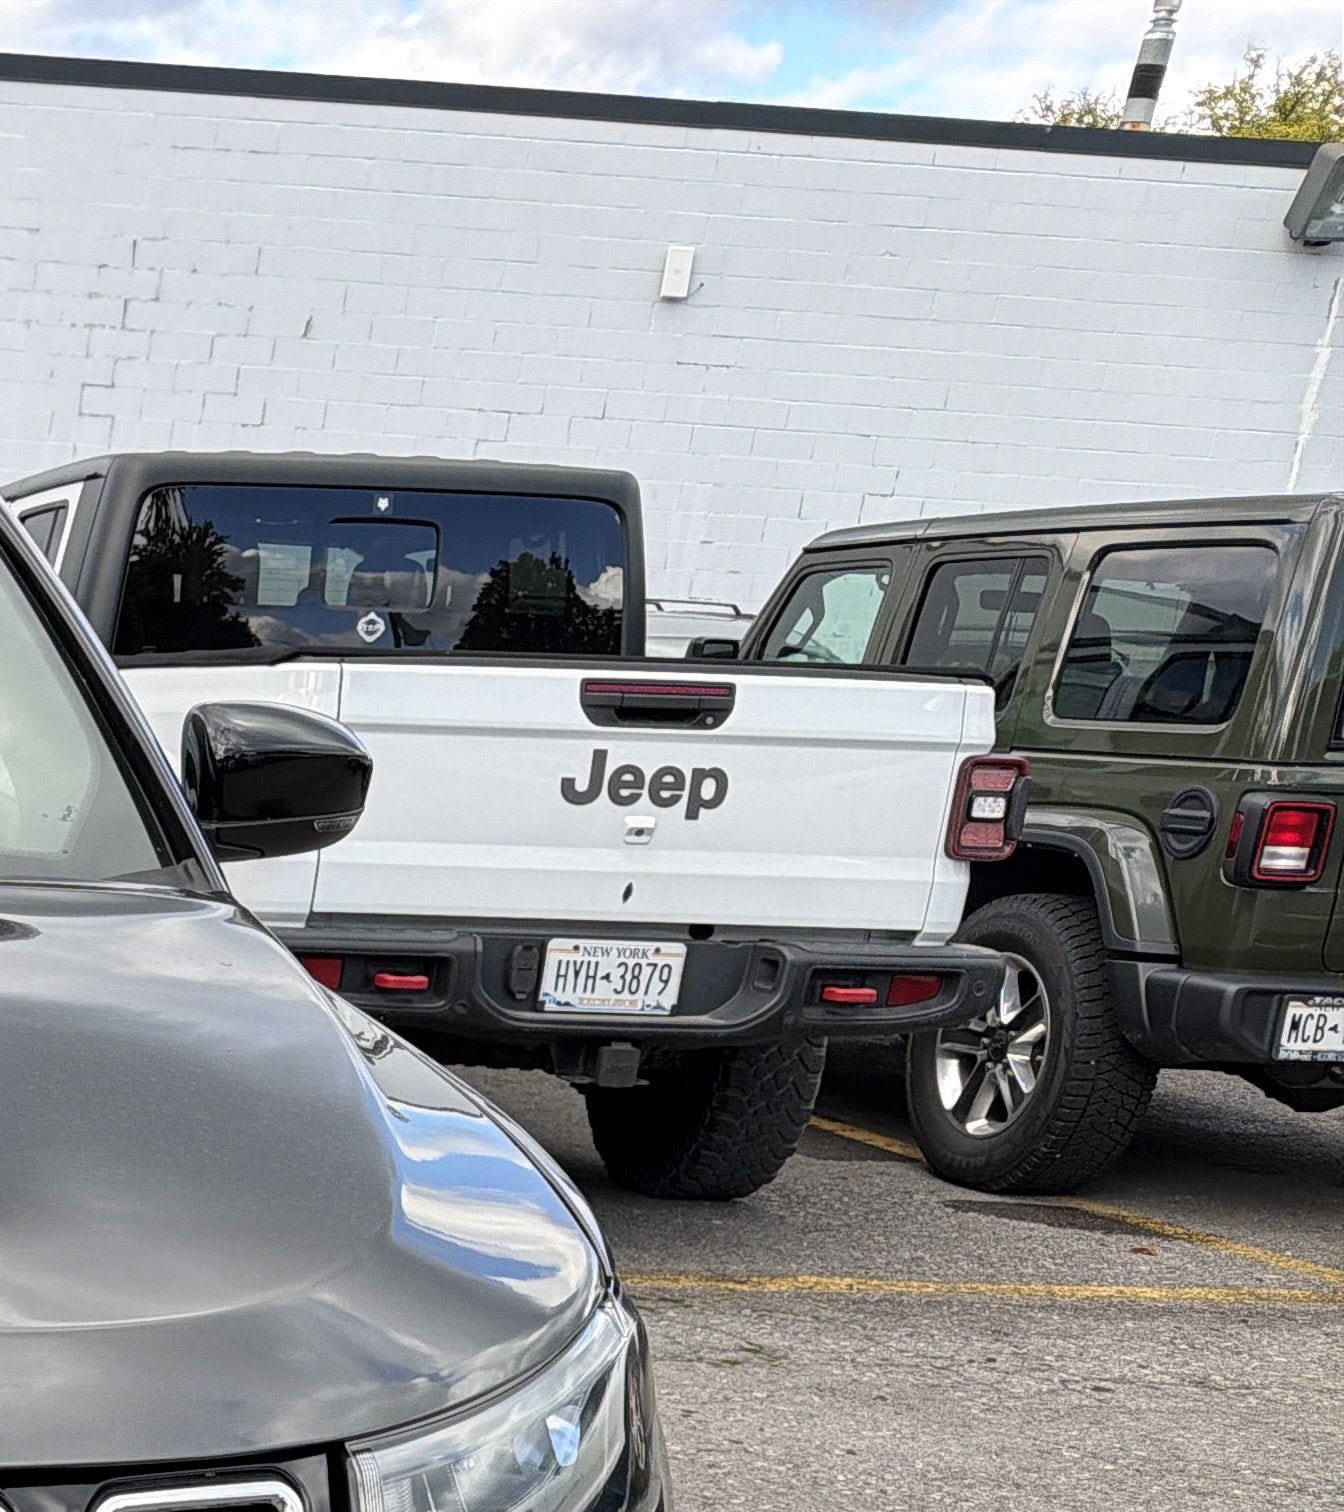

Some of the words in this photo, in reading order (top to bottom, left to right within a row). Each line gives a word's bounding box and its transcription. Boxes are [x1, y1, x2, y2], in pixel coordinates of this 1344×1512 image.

[560, 748, 729, 821] Jeep
[581, 945, 613, 958] NEW
[615, 946, 651, 960] YORK
[553, 958, 600, 995] HYH
[613, 961, 673, 997] 3879
[1286, 1012, 1328, 1044] MCB
